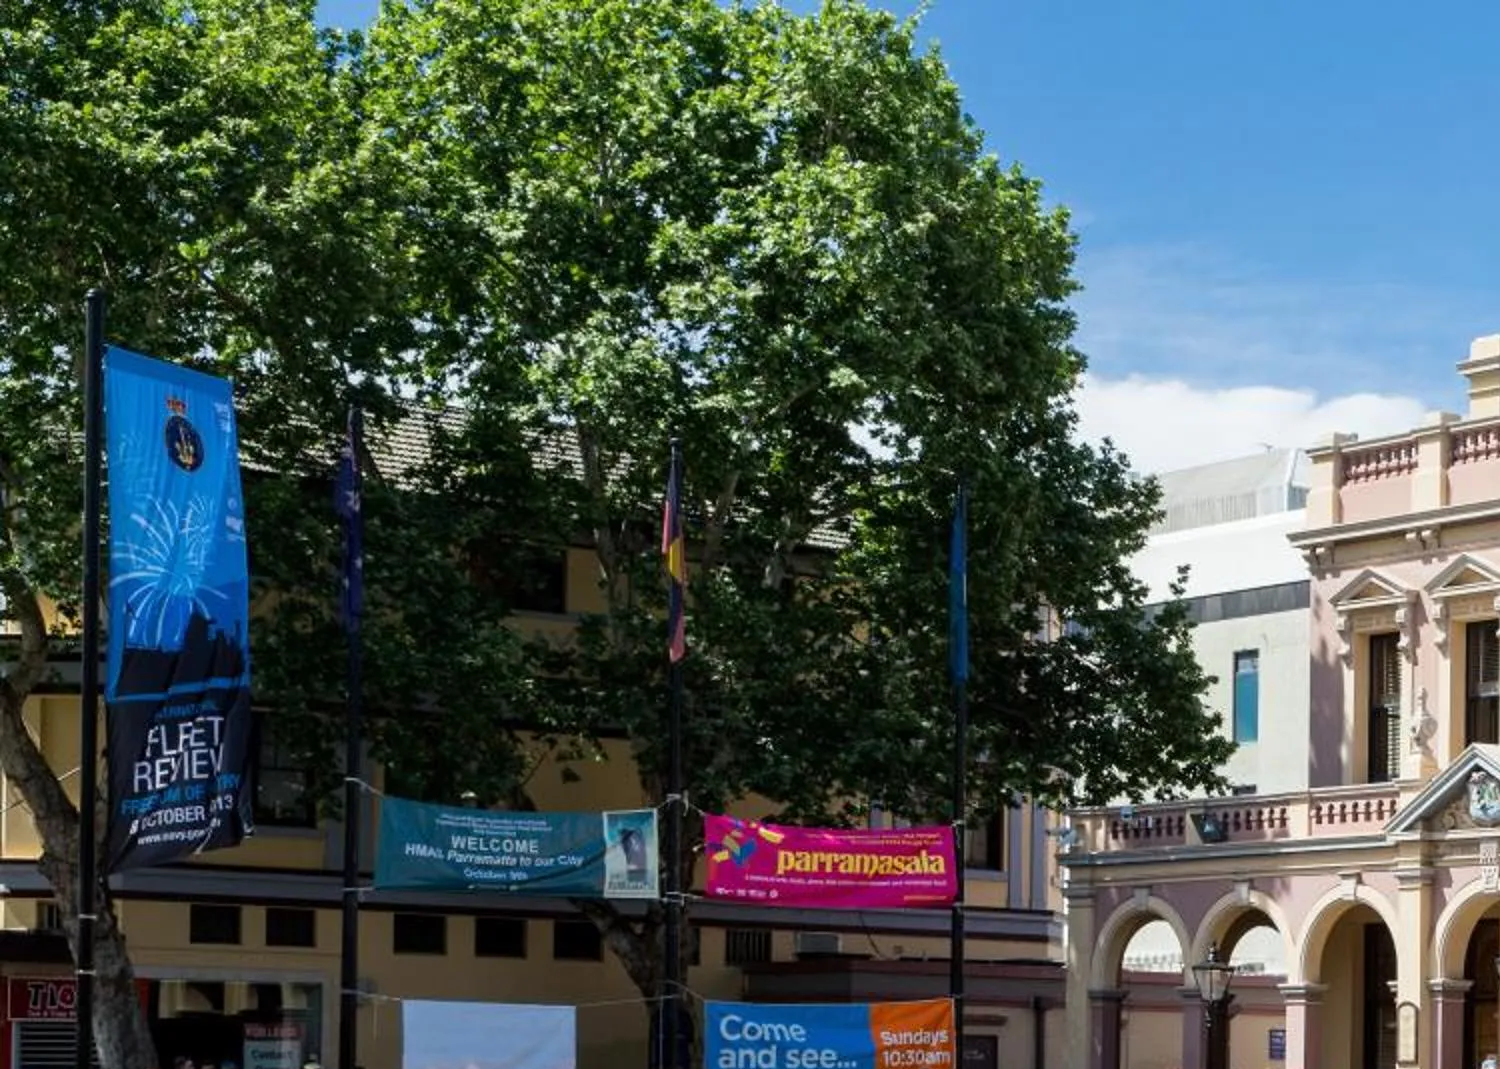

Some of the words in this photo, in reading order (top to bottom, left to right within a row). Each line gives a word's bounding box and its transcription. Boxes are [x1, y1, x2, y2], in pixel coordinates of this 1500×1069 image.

[141, 805, 206, 830] OCTOBER
[451, 835, 540, 854] WELCOME
[447, 850, 519, 867] Parramatta
[519, 855, 532, 867] to
[535, 857, 554, 868] our
[557, 854, 586, 868] City
[776, 849, 946, 879] parramasala
[719, 1014, 807, 1042] Come
[880, 1028, 950, 1047] Sundays
[718, 1046, 777, 1069] and
[786, 1049, 858, 1069] see...
[883, 1049, 952, 1067] 10:30am
